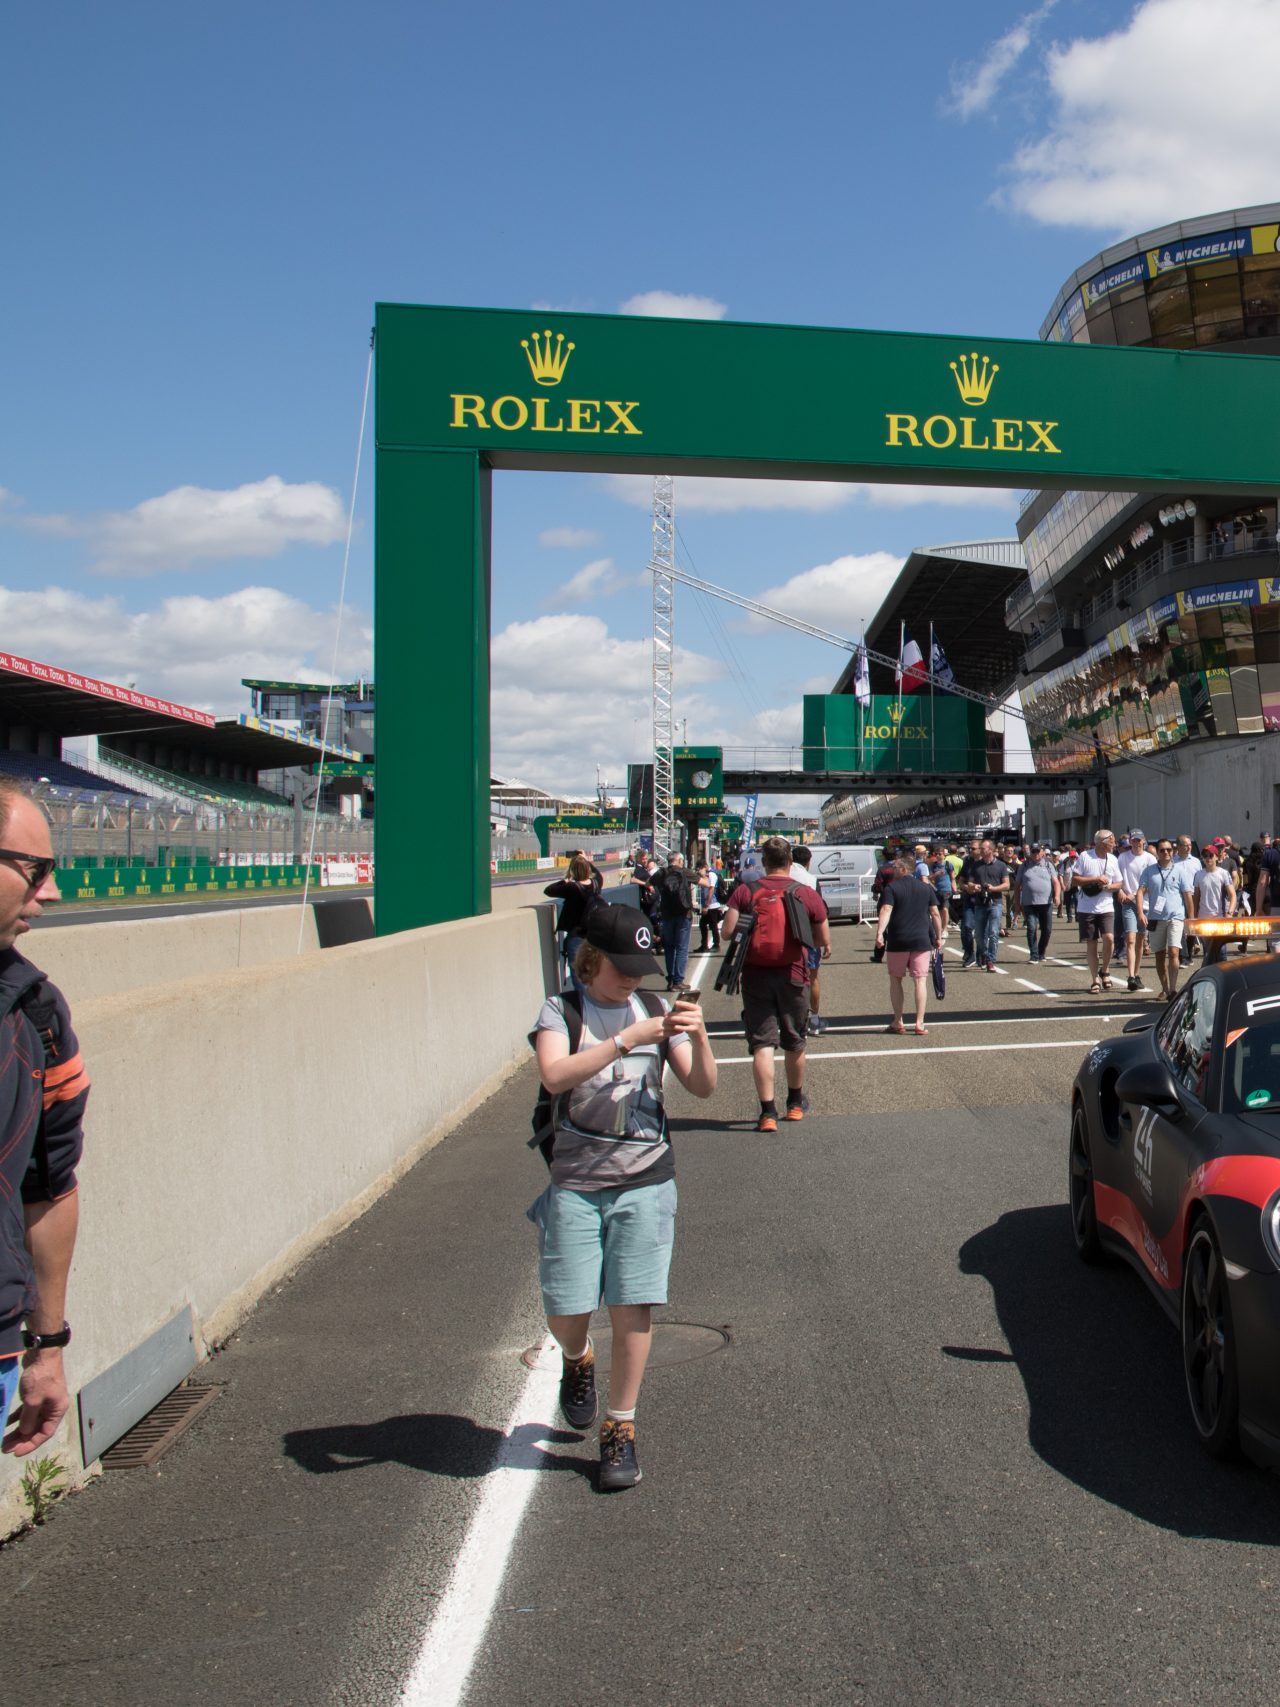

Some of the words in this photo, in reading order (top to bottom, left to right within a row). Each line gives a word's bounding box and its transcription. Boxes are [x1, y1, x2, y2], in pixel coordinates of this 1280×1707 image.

[1175, 238, 1245, 262] MICHELIN
[1098, 264, 1144, 292] MICHELIN
[449, 393, 643, 435] ROLEX
[885, 413, 1062, 453] ROLEX
[1196, 588, 1254, 605] MICHELIN
[11, 657, 29, 672] TOTAL
[31, 663, 48, 678] TOTAL
[49, 668, 65, 682] TOTAL
[67, 674, 83, 687] TOTAL
[864, 725, 928, 739] ROLEX
[78, 888, 96, 898] ROLEX
